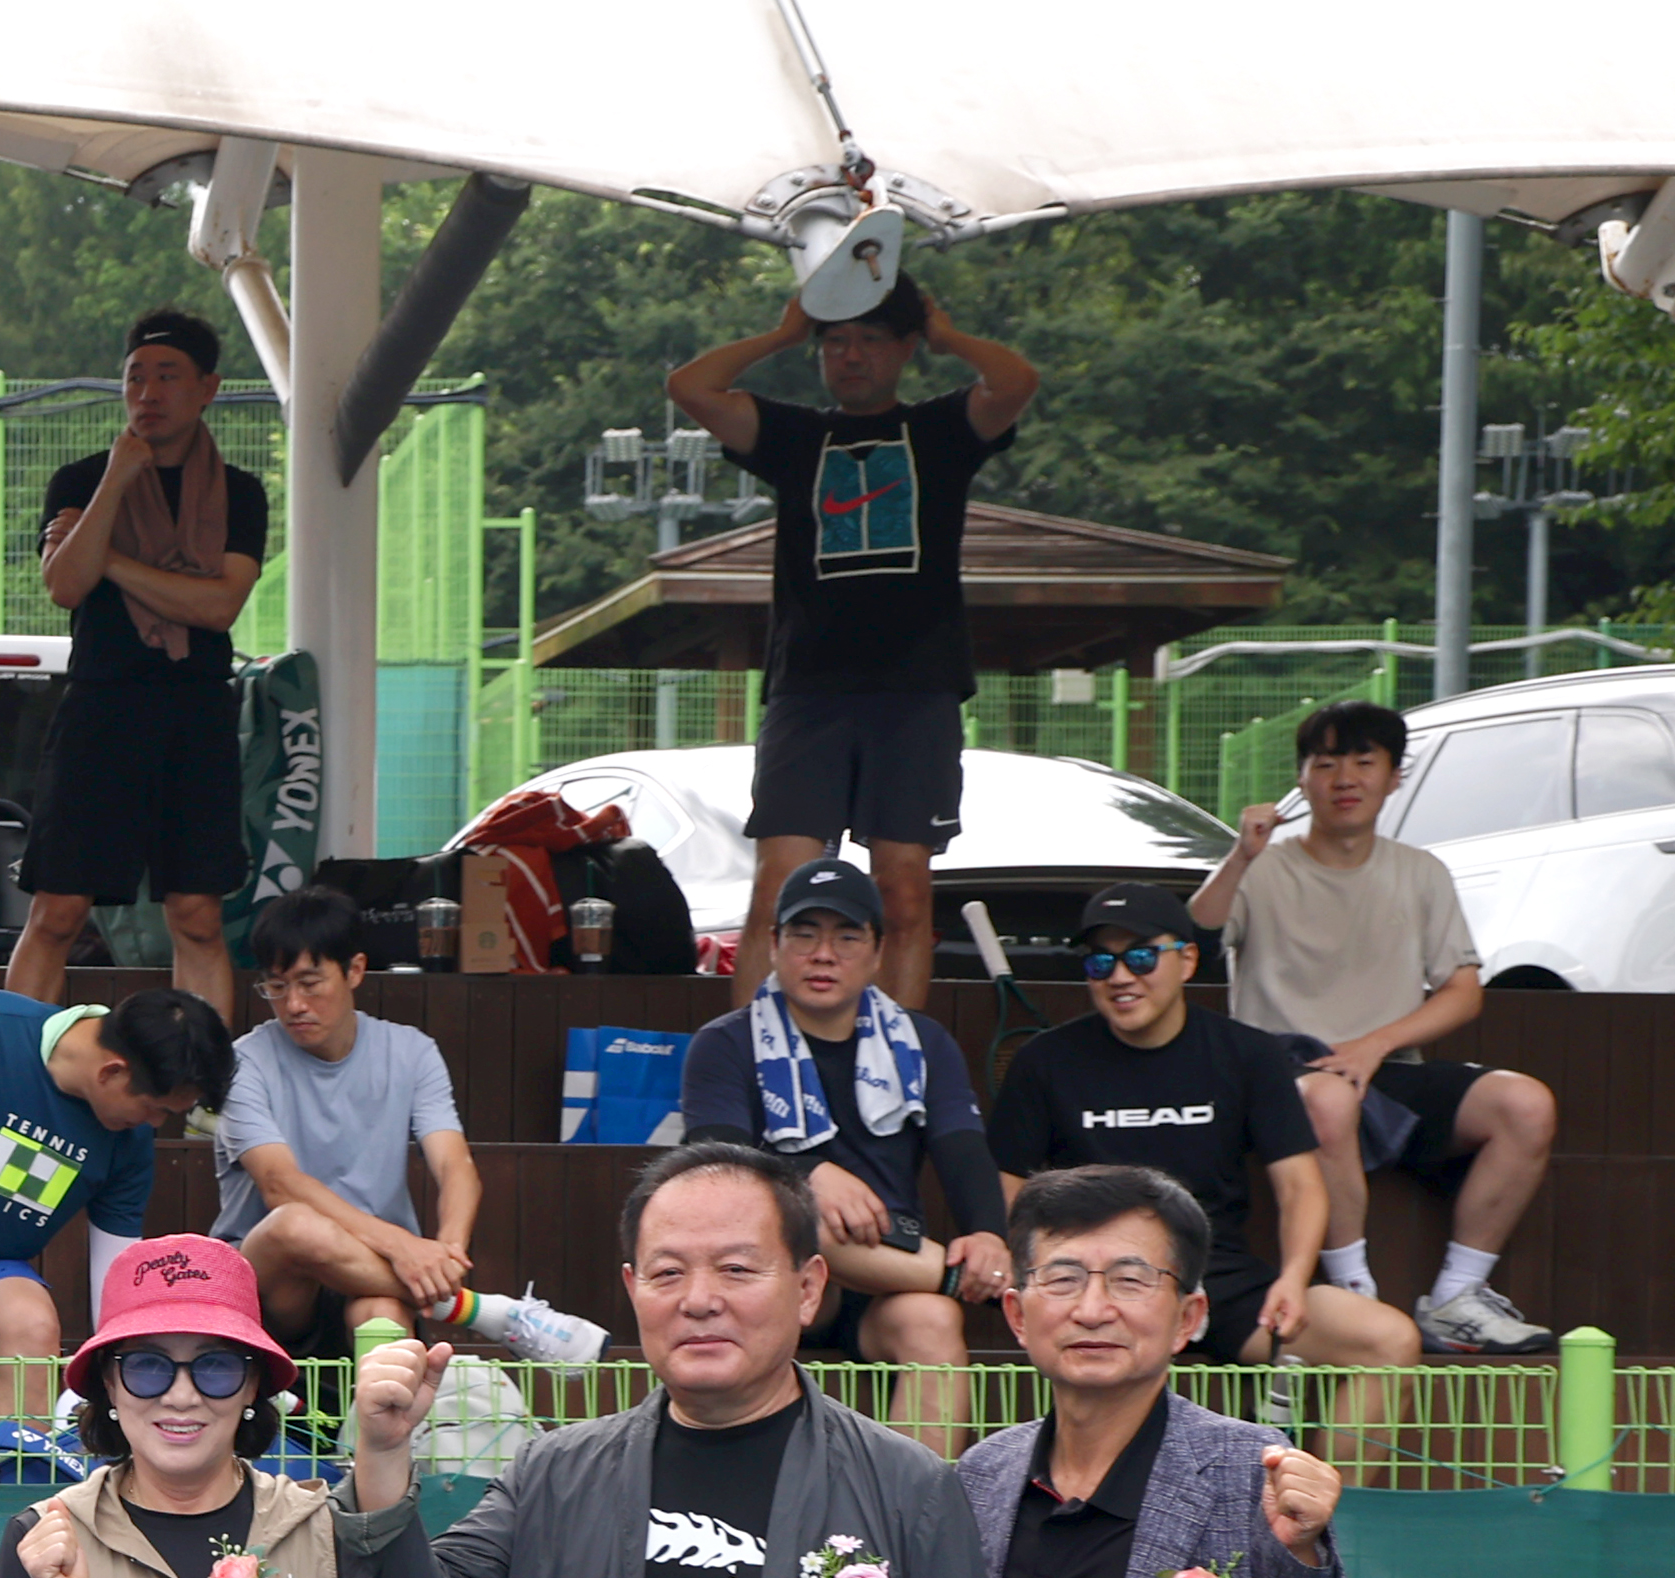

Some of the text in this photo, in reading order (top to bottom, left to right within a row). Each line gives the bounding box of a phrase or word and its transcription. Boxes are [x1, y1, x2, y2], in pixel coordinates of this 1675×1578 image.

[271, 708, 320, 831] YONEX
[1082, 1105, 1215, 1128] HEAD
[5, 1113, 89, 1162] TENNIS
[134, 1251, 192, 1287] Pearly
[160, 1267, 211, 1288] Gates
